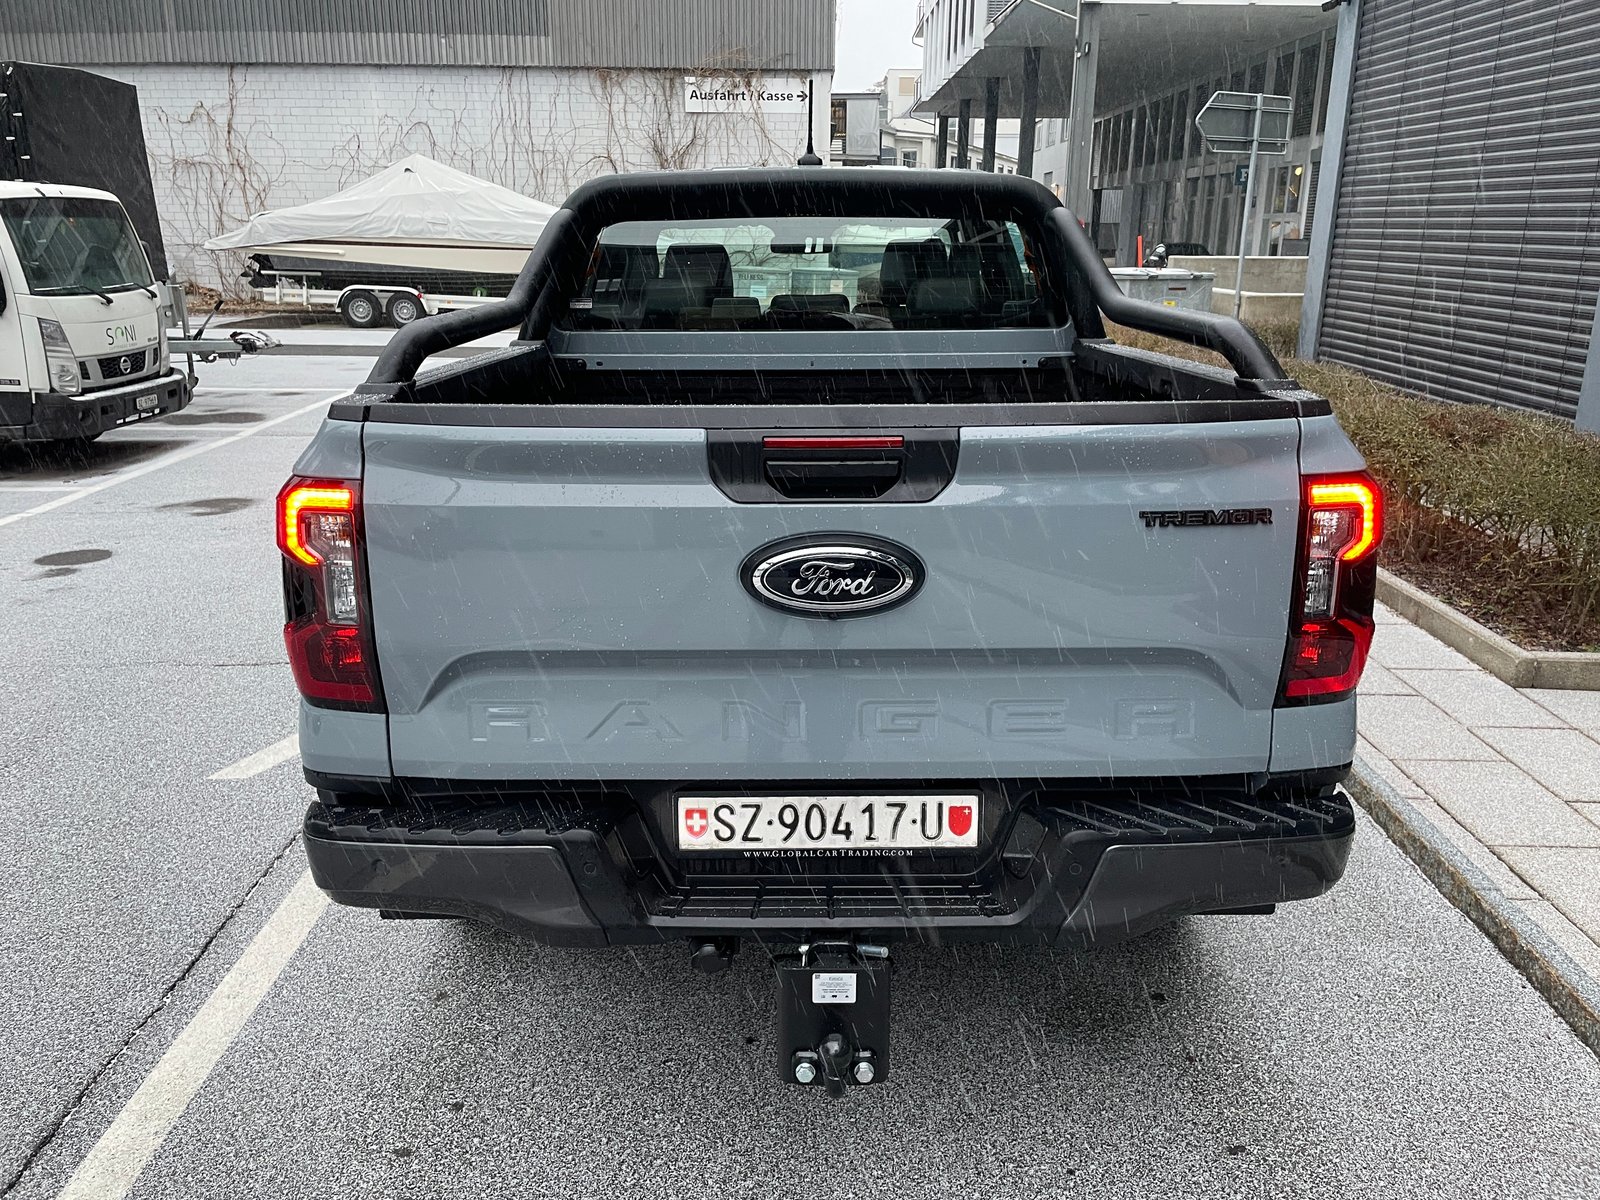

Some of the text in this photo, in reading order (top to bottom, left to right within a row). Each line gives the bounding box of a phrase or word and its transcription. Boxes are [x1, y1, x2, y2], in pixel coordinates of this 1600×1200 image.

[690, 90, 746, 101] Ausfahrt
[758, 90, 794, 101] Kasse
[1138, 508, 1274, 527] TREMOR
[791, 560, 877, 596] Ford
[465, 697, 1199, 743] RANGER
